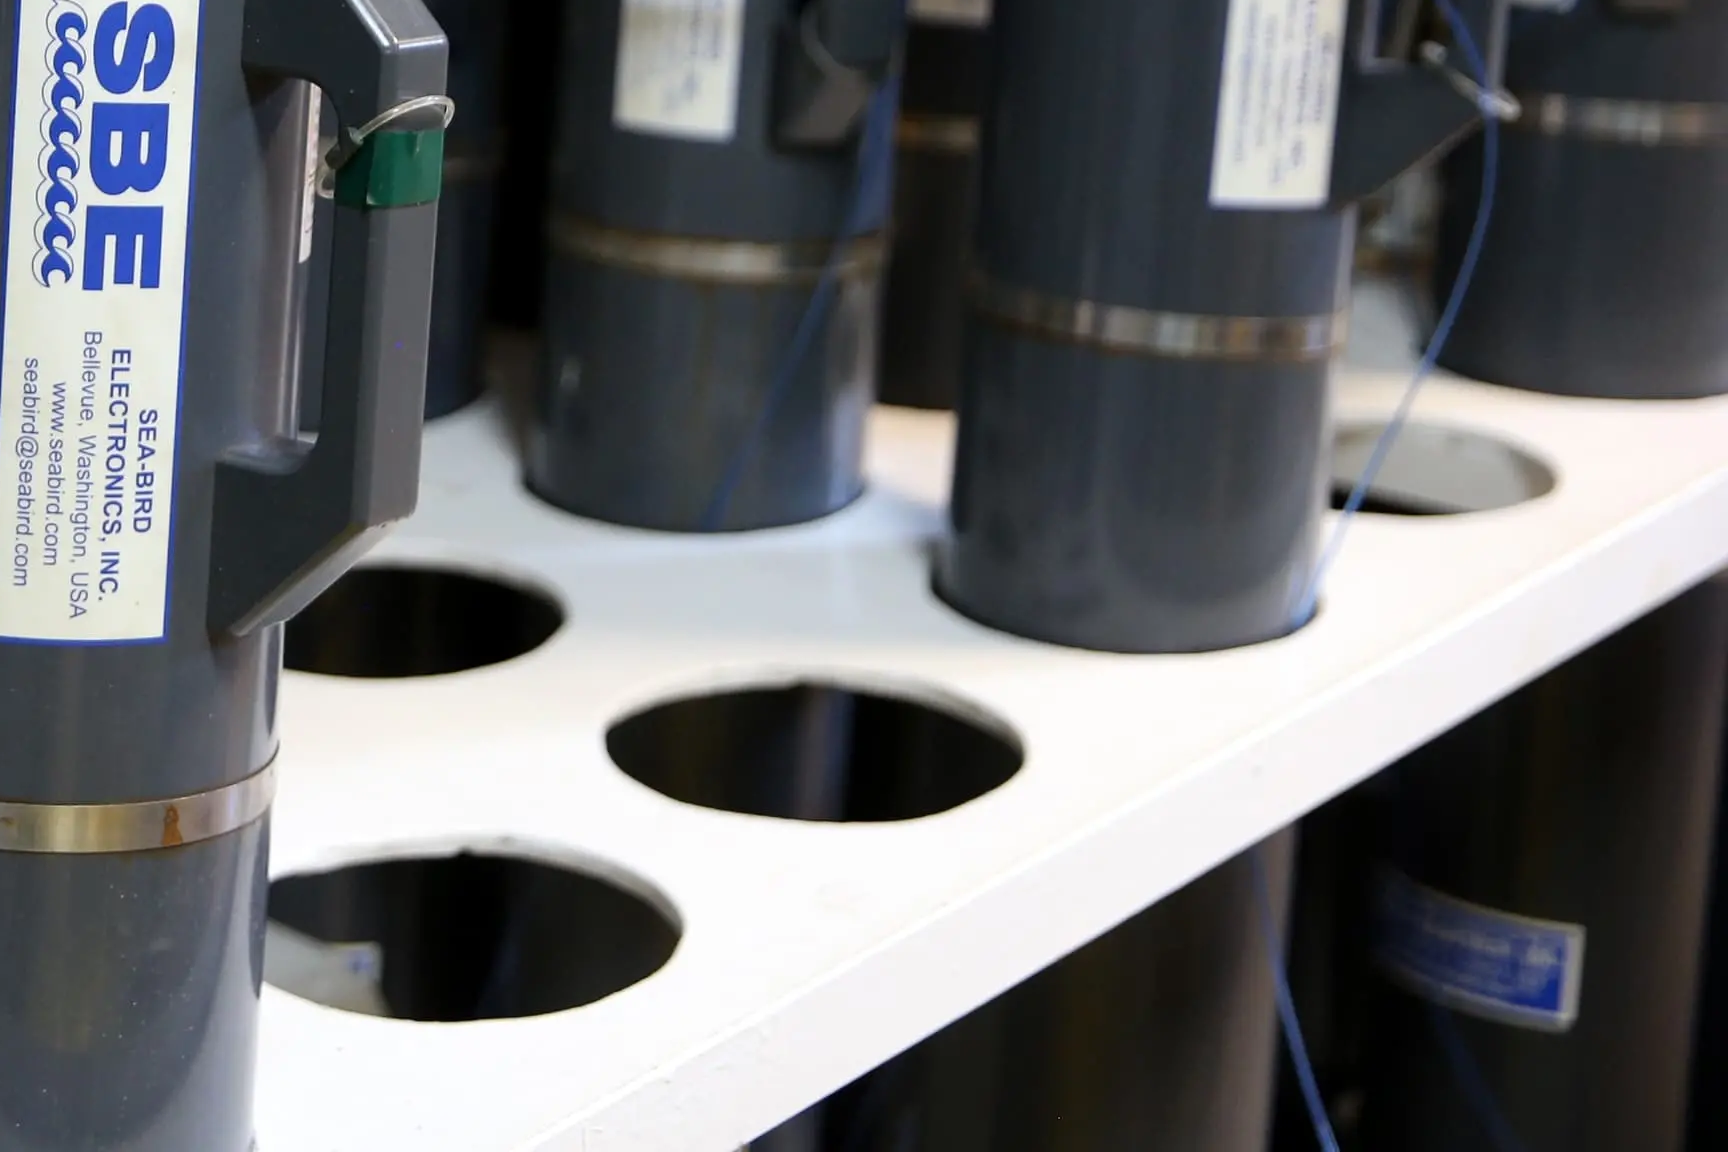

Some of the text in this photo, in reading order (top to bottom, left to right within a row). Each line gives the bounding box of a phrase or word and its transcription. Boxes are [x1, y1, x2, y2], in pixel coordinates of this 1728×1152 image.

[82, 1, 175, 290] SBE
[13, 358, 39, 587] seabird@seabird.com
[43, 382, 67, 566] www.seabird.com
[69, 331, 103, 619] Bellevue, Washington, USA
[97, 349, 132, 601] ELECTRONICS, INC.
[133, 408, 158, 533] SEA-BIRD
